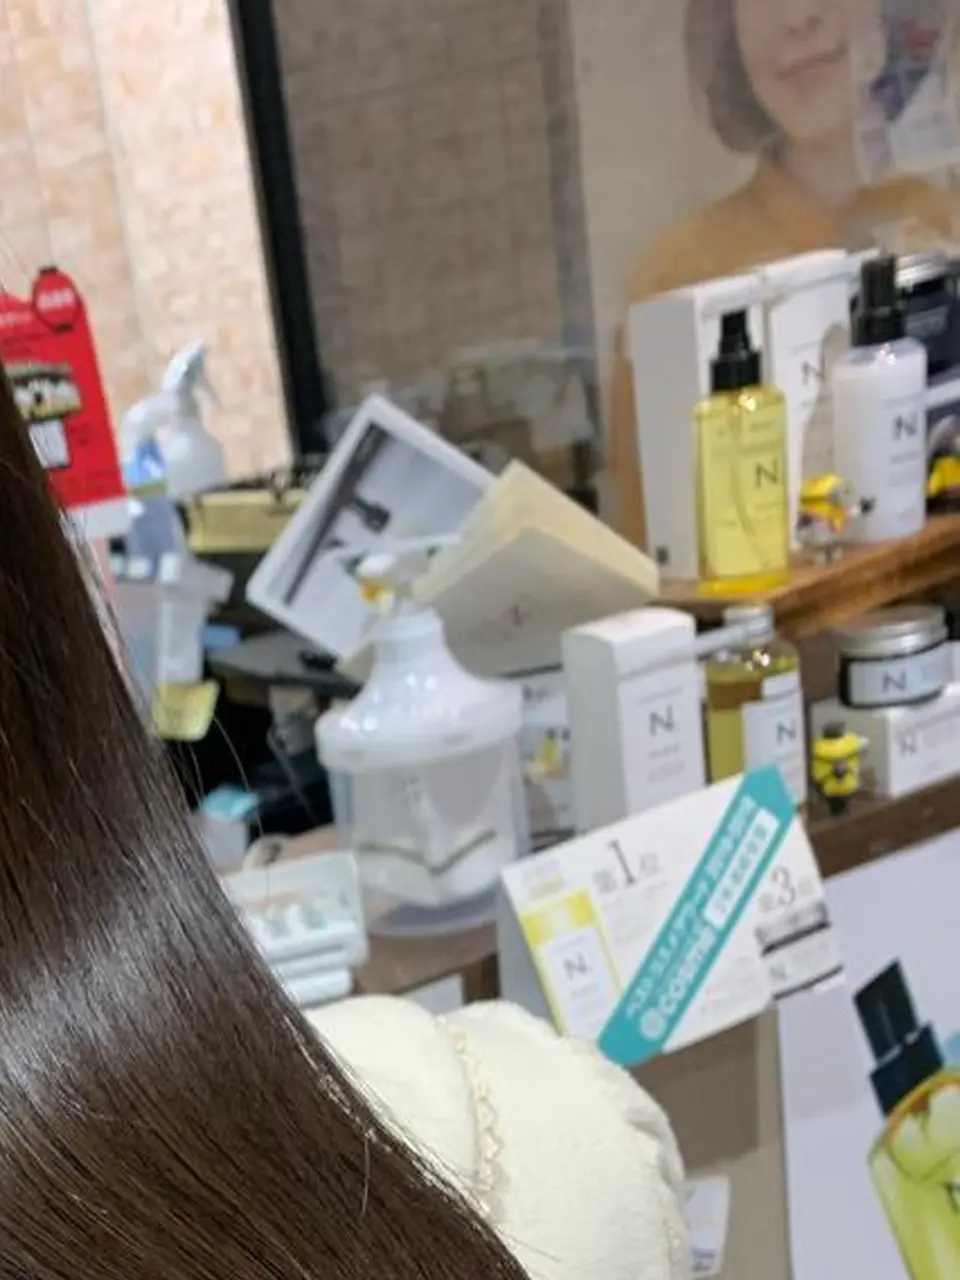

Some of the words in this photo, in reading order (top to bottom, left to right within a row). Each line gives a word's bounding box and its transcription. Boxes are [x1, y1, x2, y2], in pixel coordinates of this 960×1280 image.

[892, 411, 918, 441] N
[755, 457, 779, 488] N
[882, 669, 908, 692] N
[649, 704, 675, 737] N
[776, 718, 797, 745] N
[562, 950, 590, 982] N
